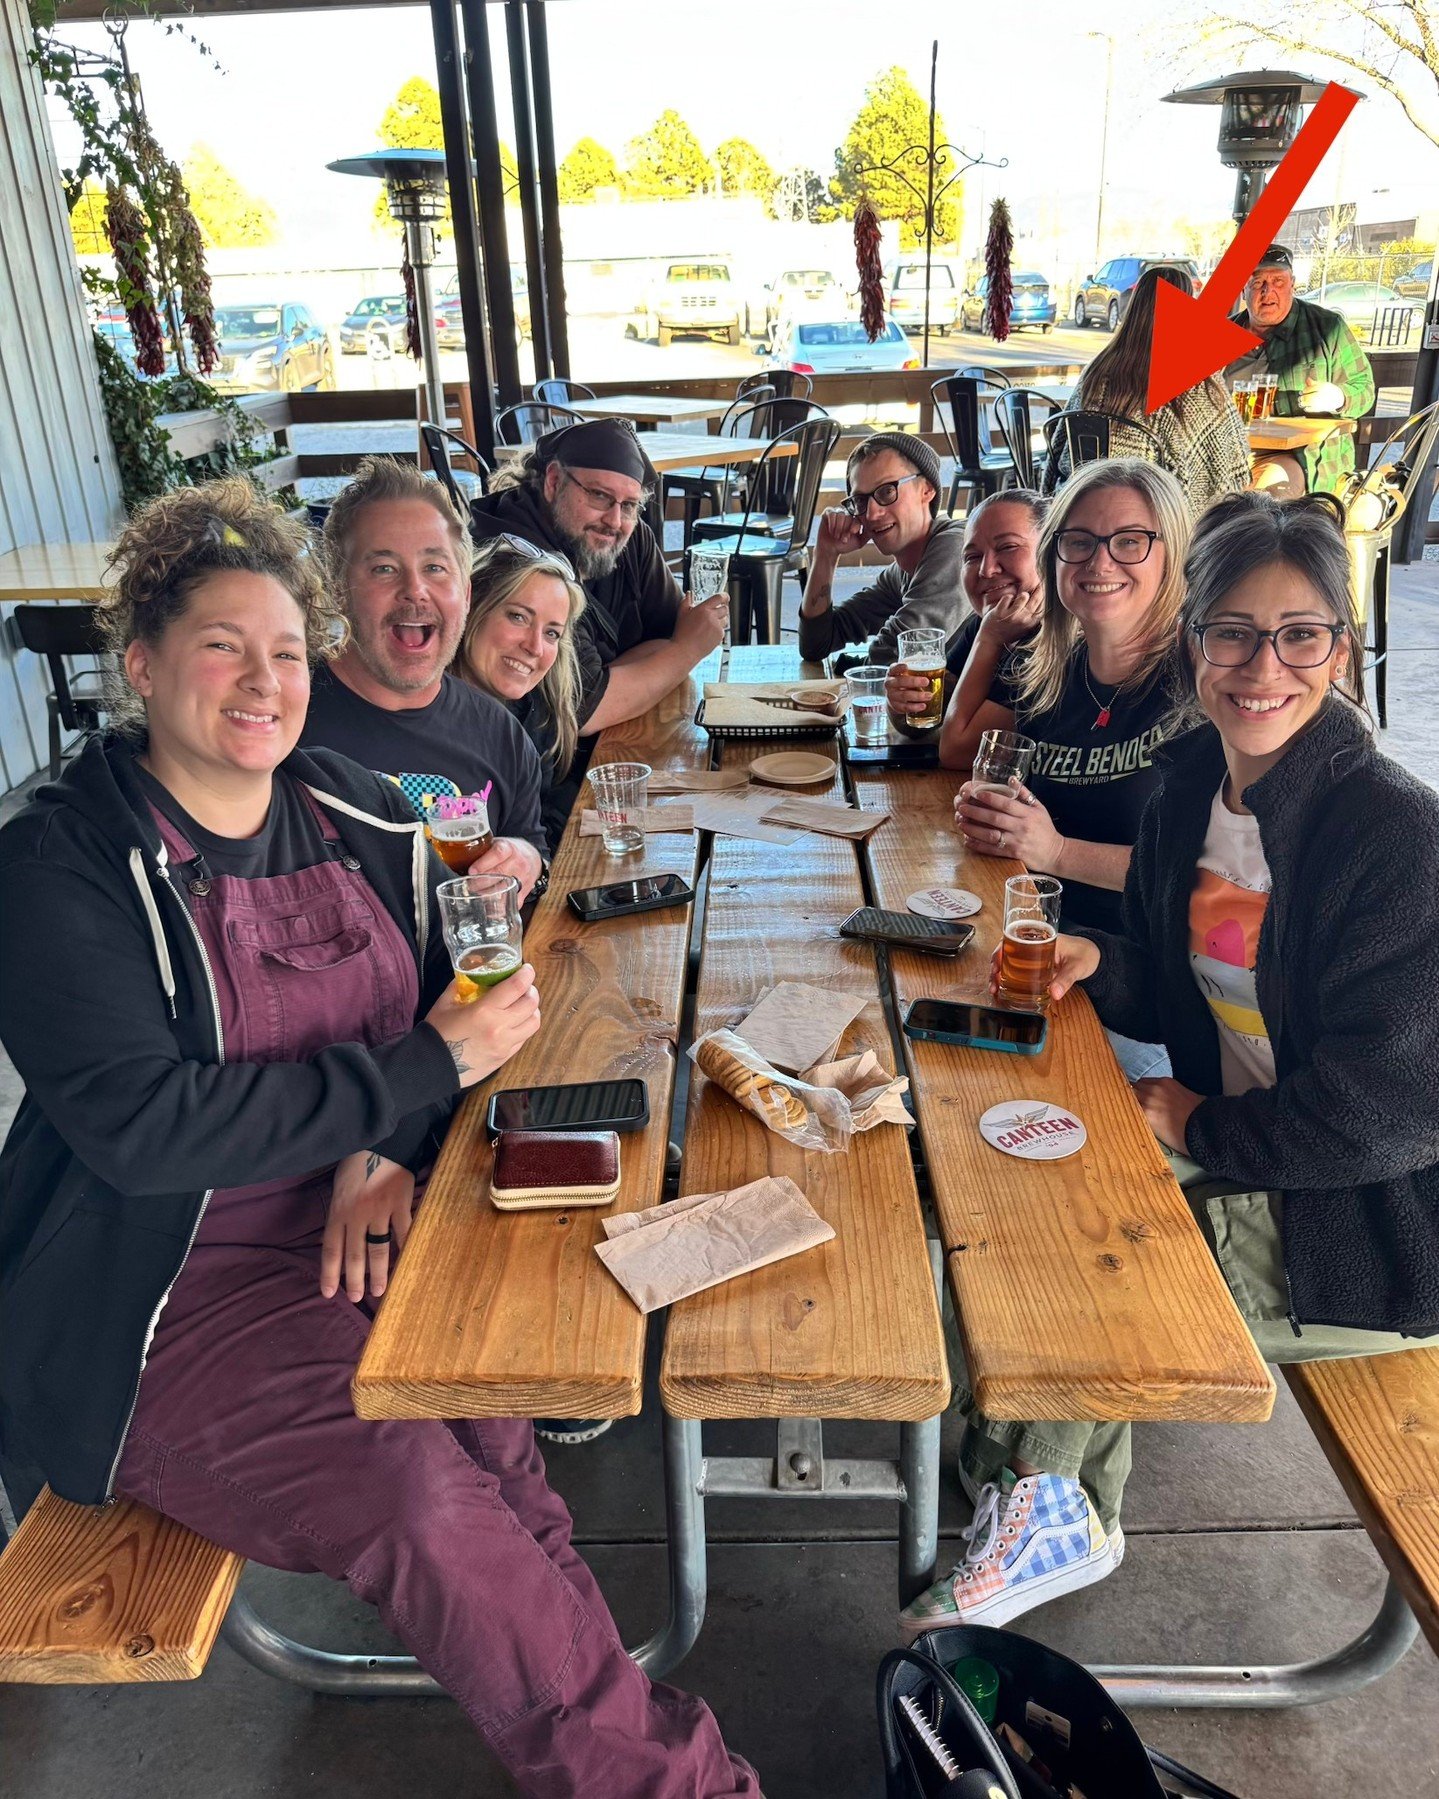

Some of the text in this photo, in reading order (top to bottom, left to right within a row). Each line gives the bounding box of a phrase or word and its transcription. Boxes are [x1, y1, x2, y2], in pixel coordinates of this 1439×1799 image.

[1031, 740, 1083, 776] STEEL
[1068, 774, 1110, 786] BREWYARD
[926, 889, 972, 915] CANTEEN
[996, 1117, 1080, 1149] CANTEEN
[1016, 1131, 1075, 1151] BREWHOUSE
